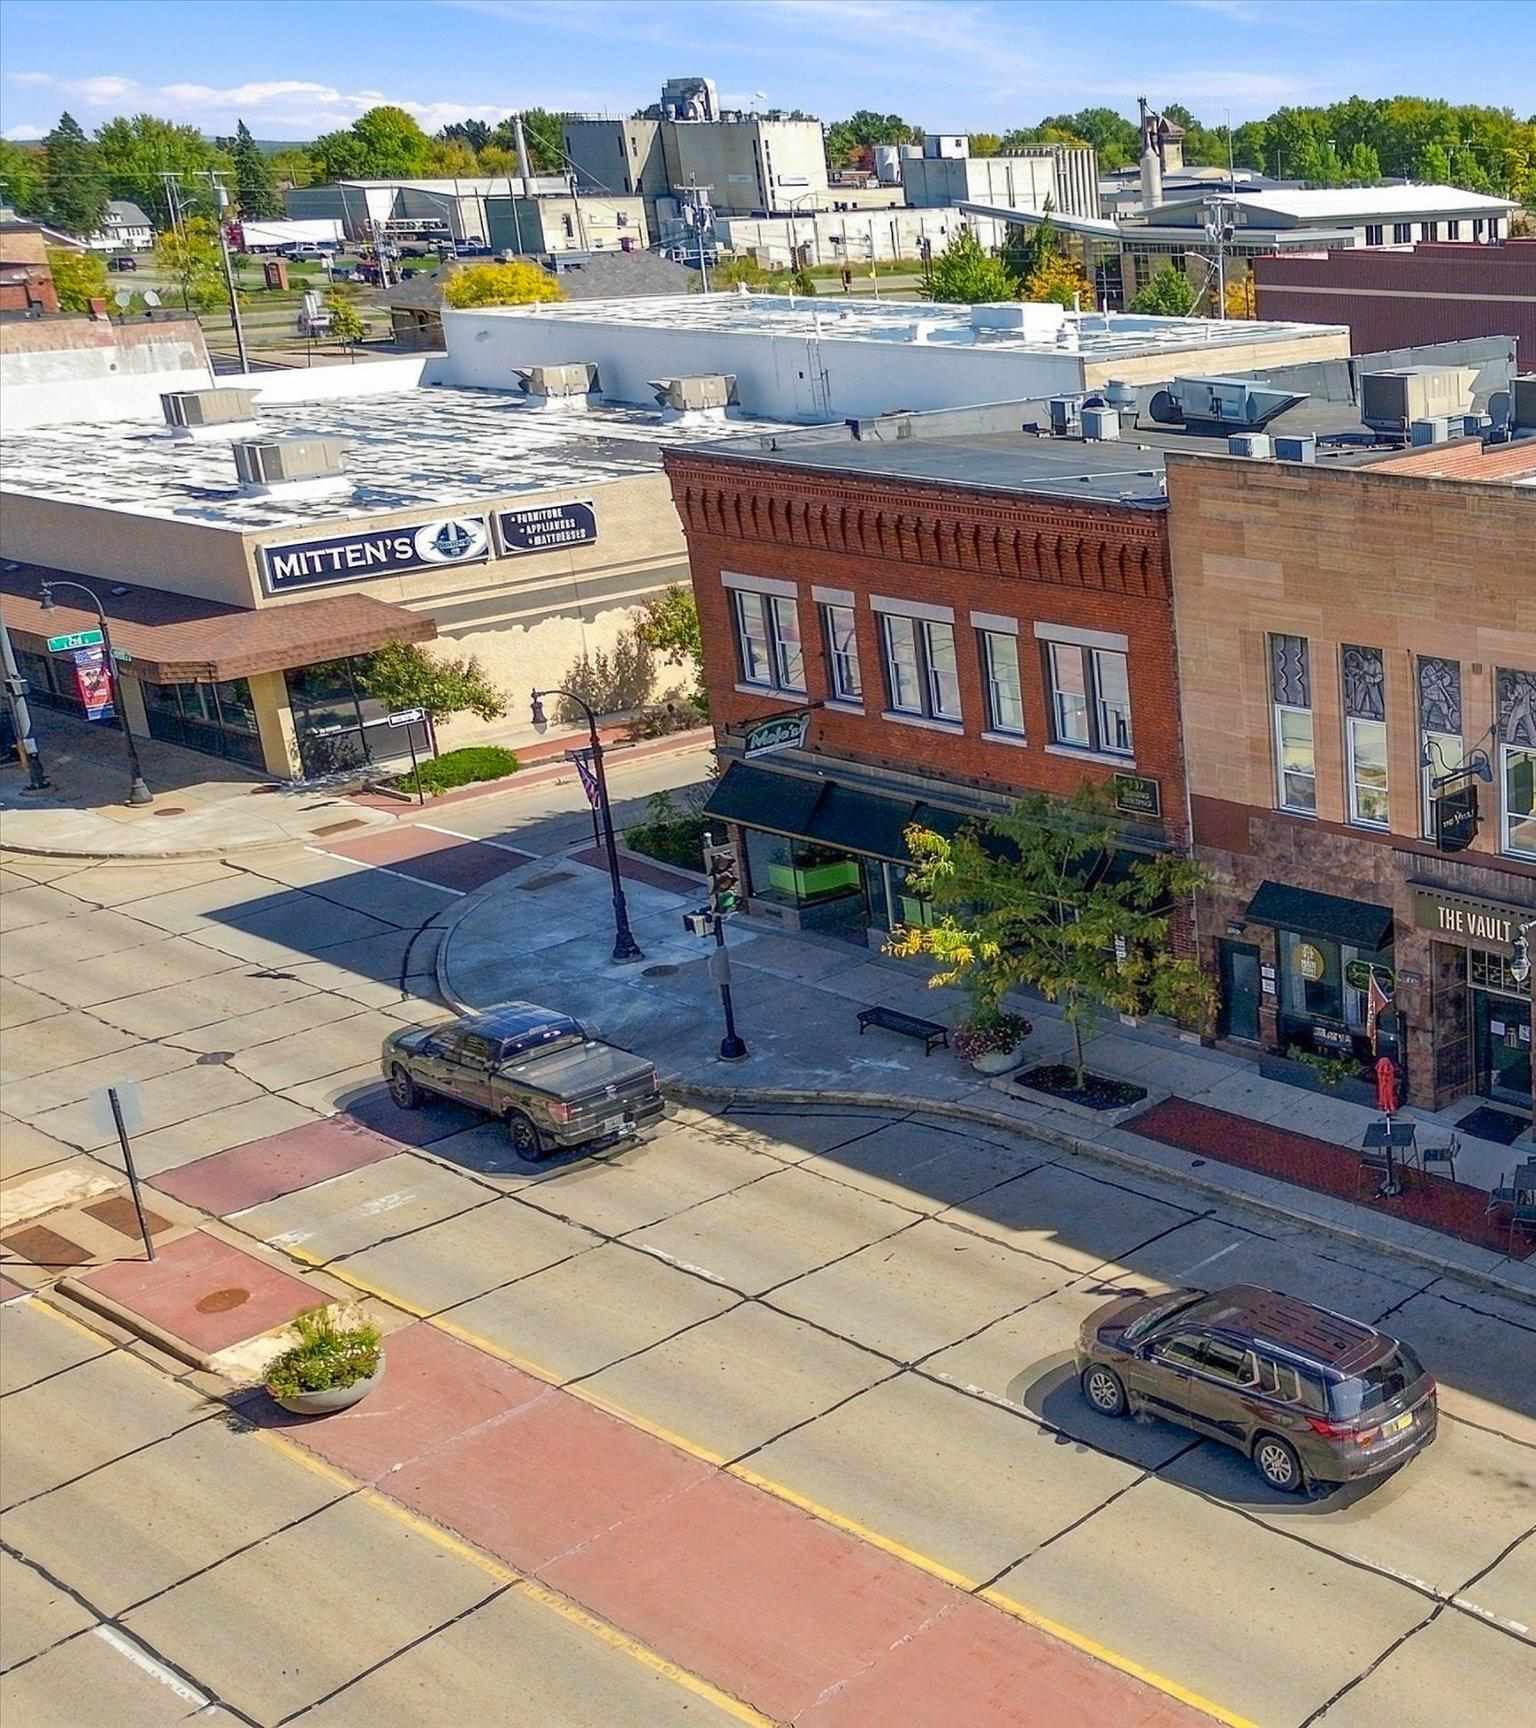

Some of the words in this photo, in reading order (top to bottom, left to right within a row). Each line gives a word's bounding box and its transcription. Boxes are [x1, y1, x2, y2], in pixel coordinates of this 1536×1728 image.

[517, 508, 563, 523] FURNITURE
[273, 537, 414, 579] MITTEN'S
[1438, 906, 1463, 932] THE
[1467, 912, 1511, 942] VAULT
